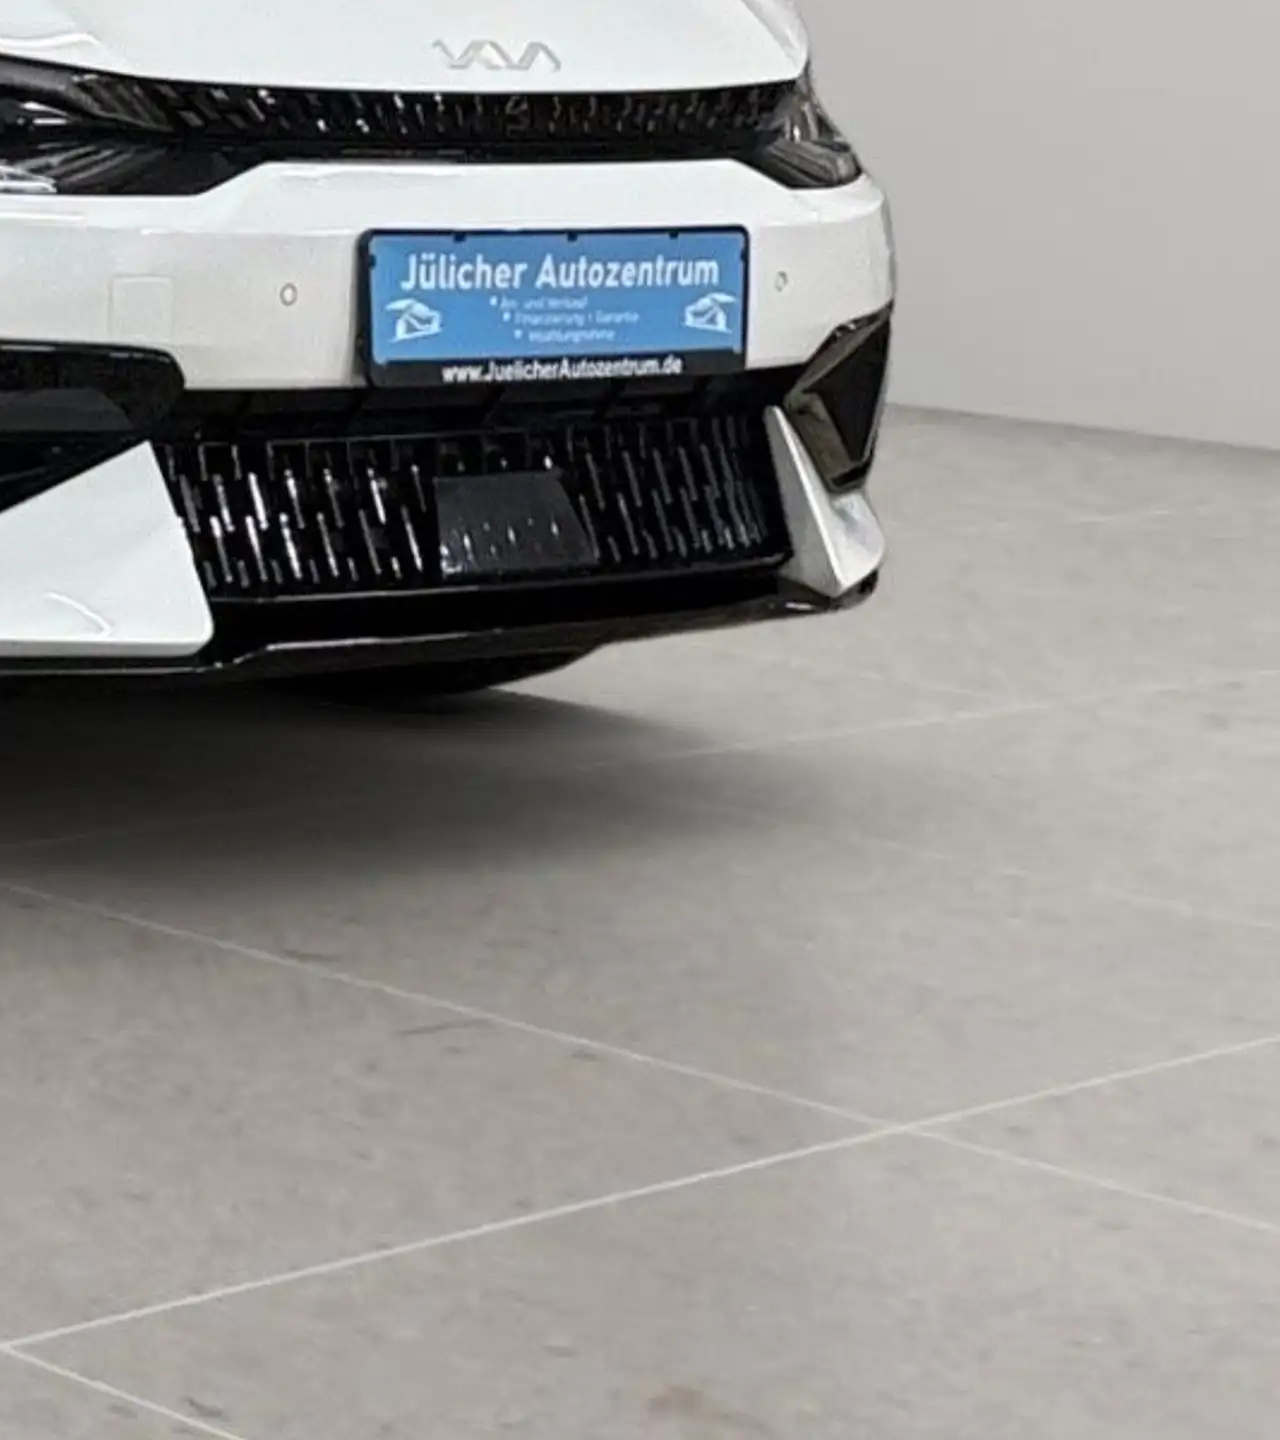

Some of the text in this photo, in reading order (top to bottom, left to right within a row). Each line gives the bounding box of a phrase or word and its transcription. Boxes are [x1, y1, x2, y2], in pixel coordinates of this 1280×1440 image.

[400, 253, 720, 290] Jülicher Autozentrum
[442, 355, 682, 383] www.JuelicherAutozentrum.de
